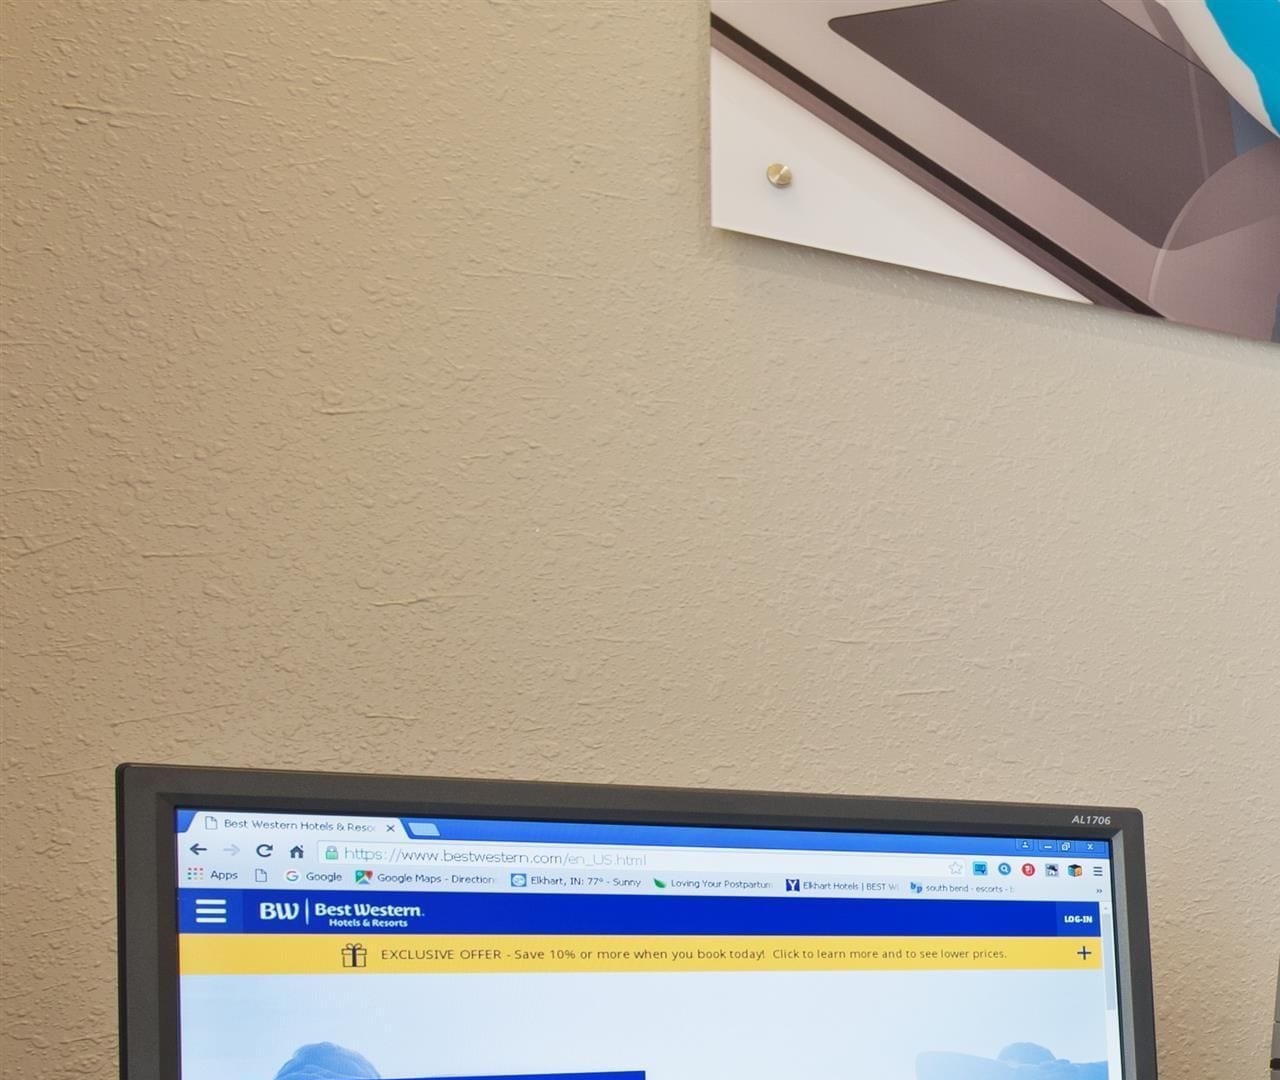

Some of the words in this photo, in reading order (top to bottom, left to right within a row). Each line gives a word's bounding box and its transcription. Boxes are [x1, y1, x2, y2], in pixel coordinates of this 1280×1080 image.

[224, 819, 248, 828] Best
[252, 820, 297, 830] Western
[301, 821, 334, 831] Hotels
[337, 822, 345, 830] &
[1072, 816, 1111, 824] AL1706
[211, 870, 238, 881] Apps
[306, 873, 342, 882] Google
[378, 874, 413, 883] Google
[415, 875, 442, 884] Maps
[531, 877, 566, 886] Elkhart,
[613, 878, 641, 888] Sunny
[671, 879, 700, 889] Loving
[704, 880, 721, 888] Your
[834, 882, 859, 890] Hotels
[866, 883, 886, 891] BEST
[950, 885, 968, 893] bend
[976, 885, 1003, 893] escorts
[259, 902, 299, 920] BW
[315, 903, 352, 916] Best
[329, 919, 361, 927] Hotels
[363, 919, 370, 927] &
[372, 919, 408, 927] Resorts
[1064, 916, 1093, 924] LOG-IN
[382, 950, 454, 960] EXCLUSIVE
[460, 950, 501, 959] OFFER
[514, 950, 544, 959] Save
[550, 950, 575, 959] 10%
[580, 951, 592, 959] or
[597, 951, 630, 959] more
[634, 950, 667, 959] when
[672, 951, 693, 961] you
[697, 949, 727, 959] book
[730, 949, 765, 961] today!
[773, 949, 799, 959] Click
[803, 951, 814, 959] to
[817, 949, 846, 959] learn
[850, 951, 878, 959] more
[882, 949, 902, 958] and
[905, 951, 917, 959] to
[941, 949, 969, 958] lower
[973, 949, 1007, 960] prices.
